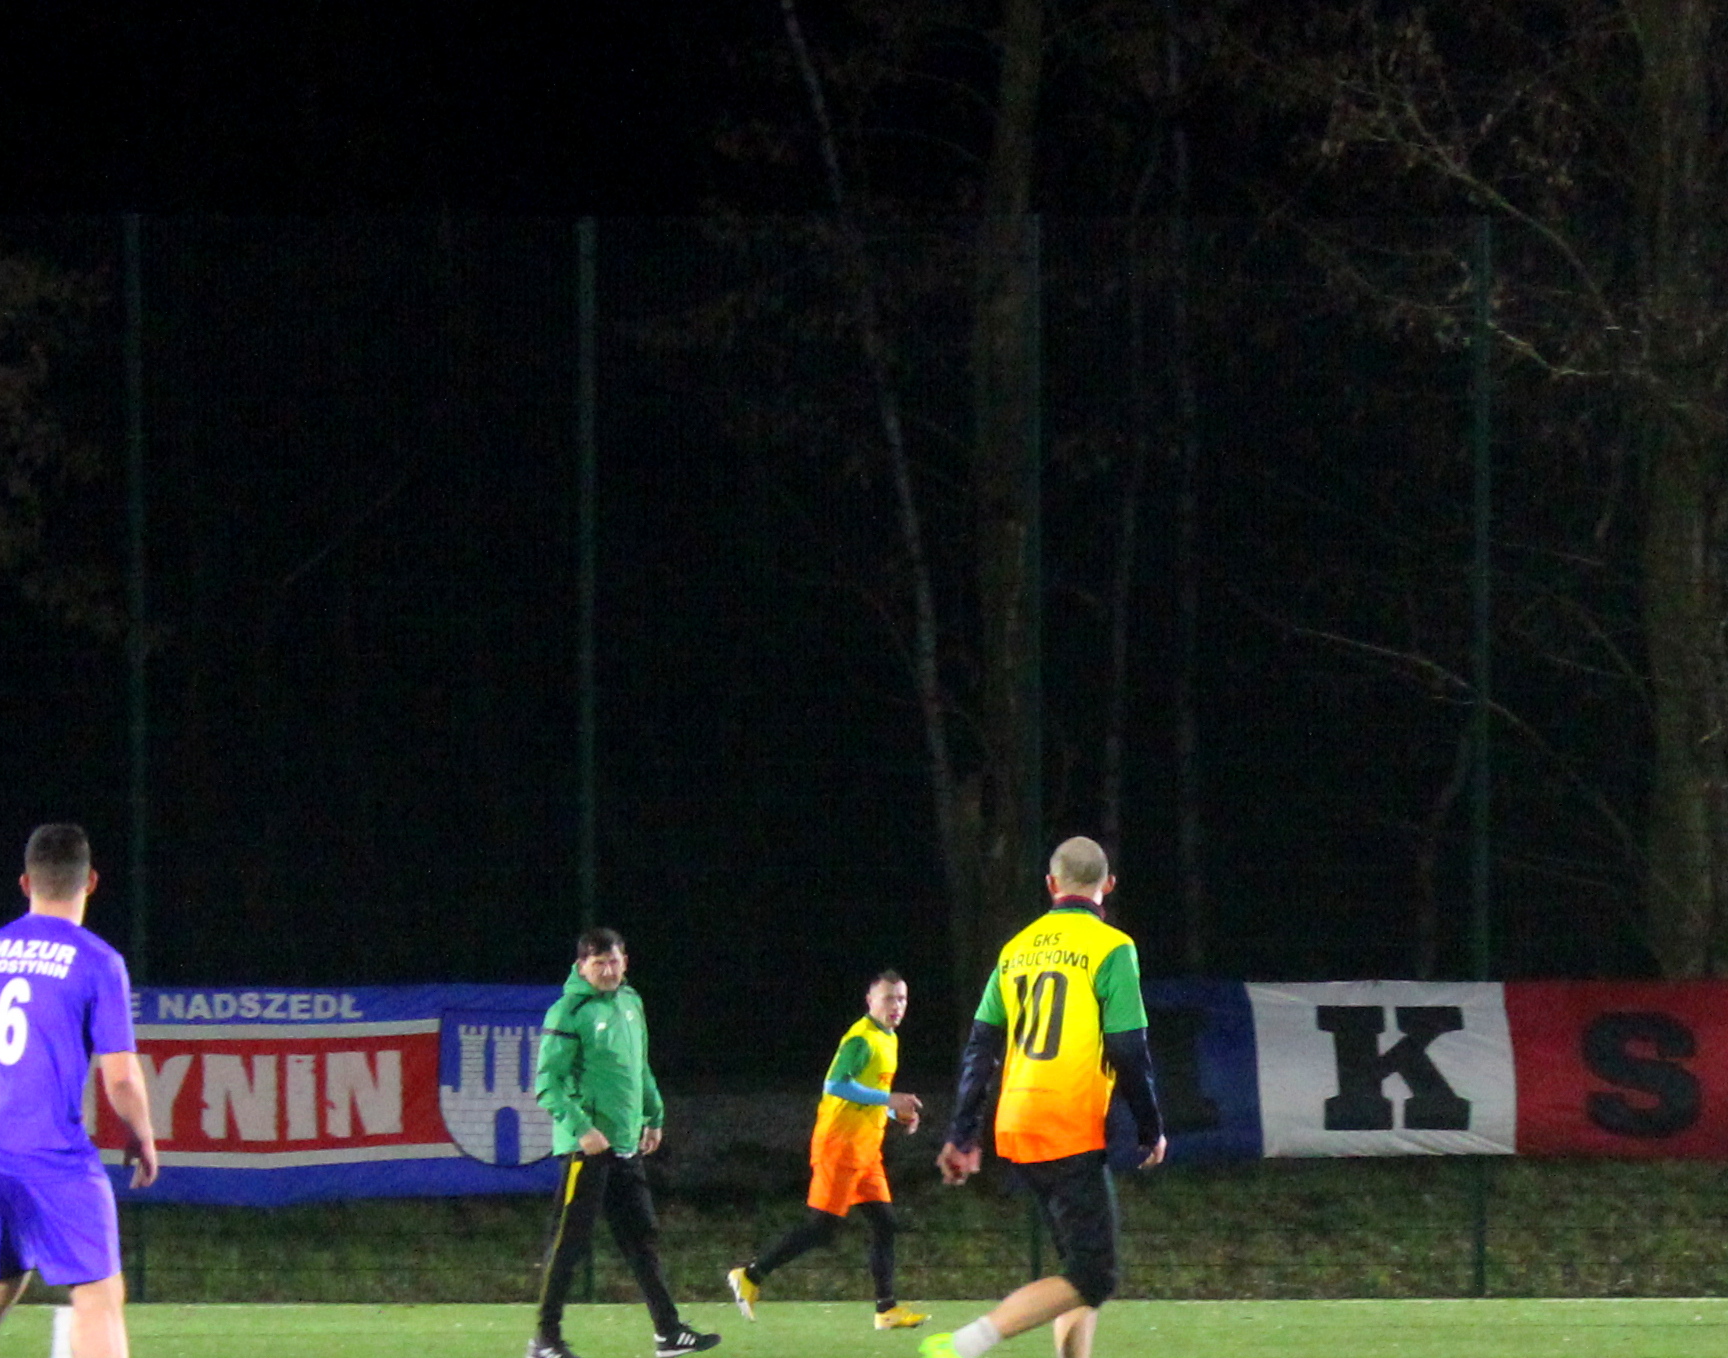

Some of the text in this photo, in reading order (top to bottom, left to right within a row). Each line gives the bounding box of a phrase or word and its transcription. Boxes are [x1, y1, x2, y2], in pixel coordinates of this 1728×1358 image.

[1033, 932, 1062, 948] GKS
[157, 992, 363, 1020] NADSZEDŁ
[1014, 970, 1069, 1061] 10
